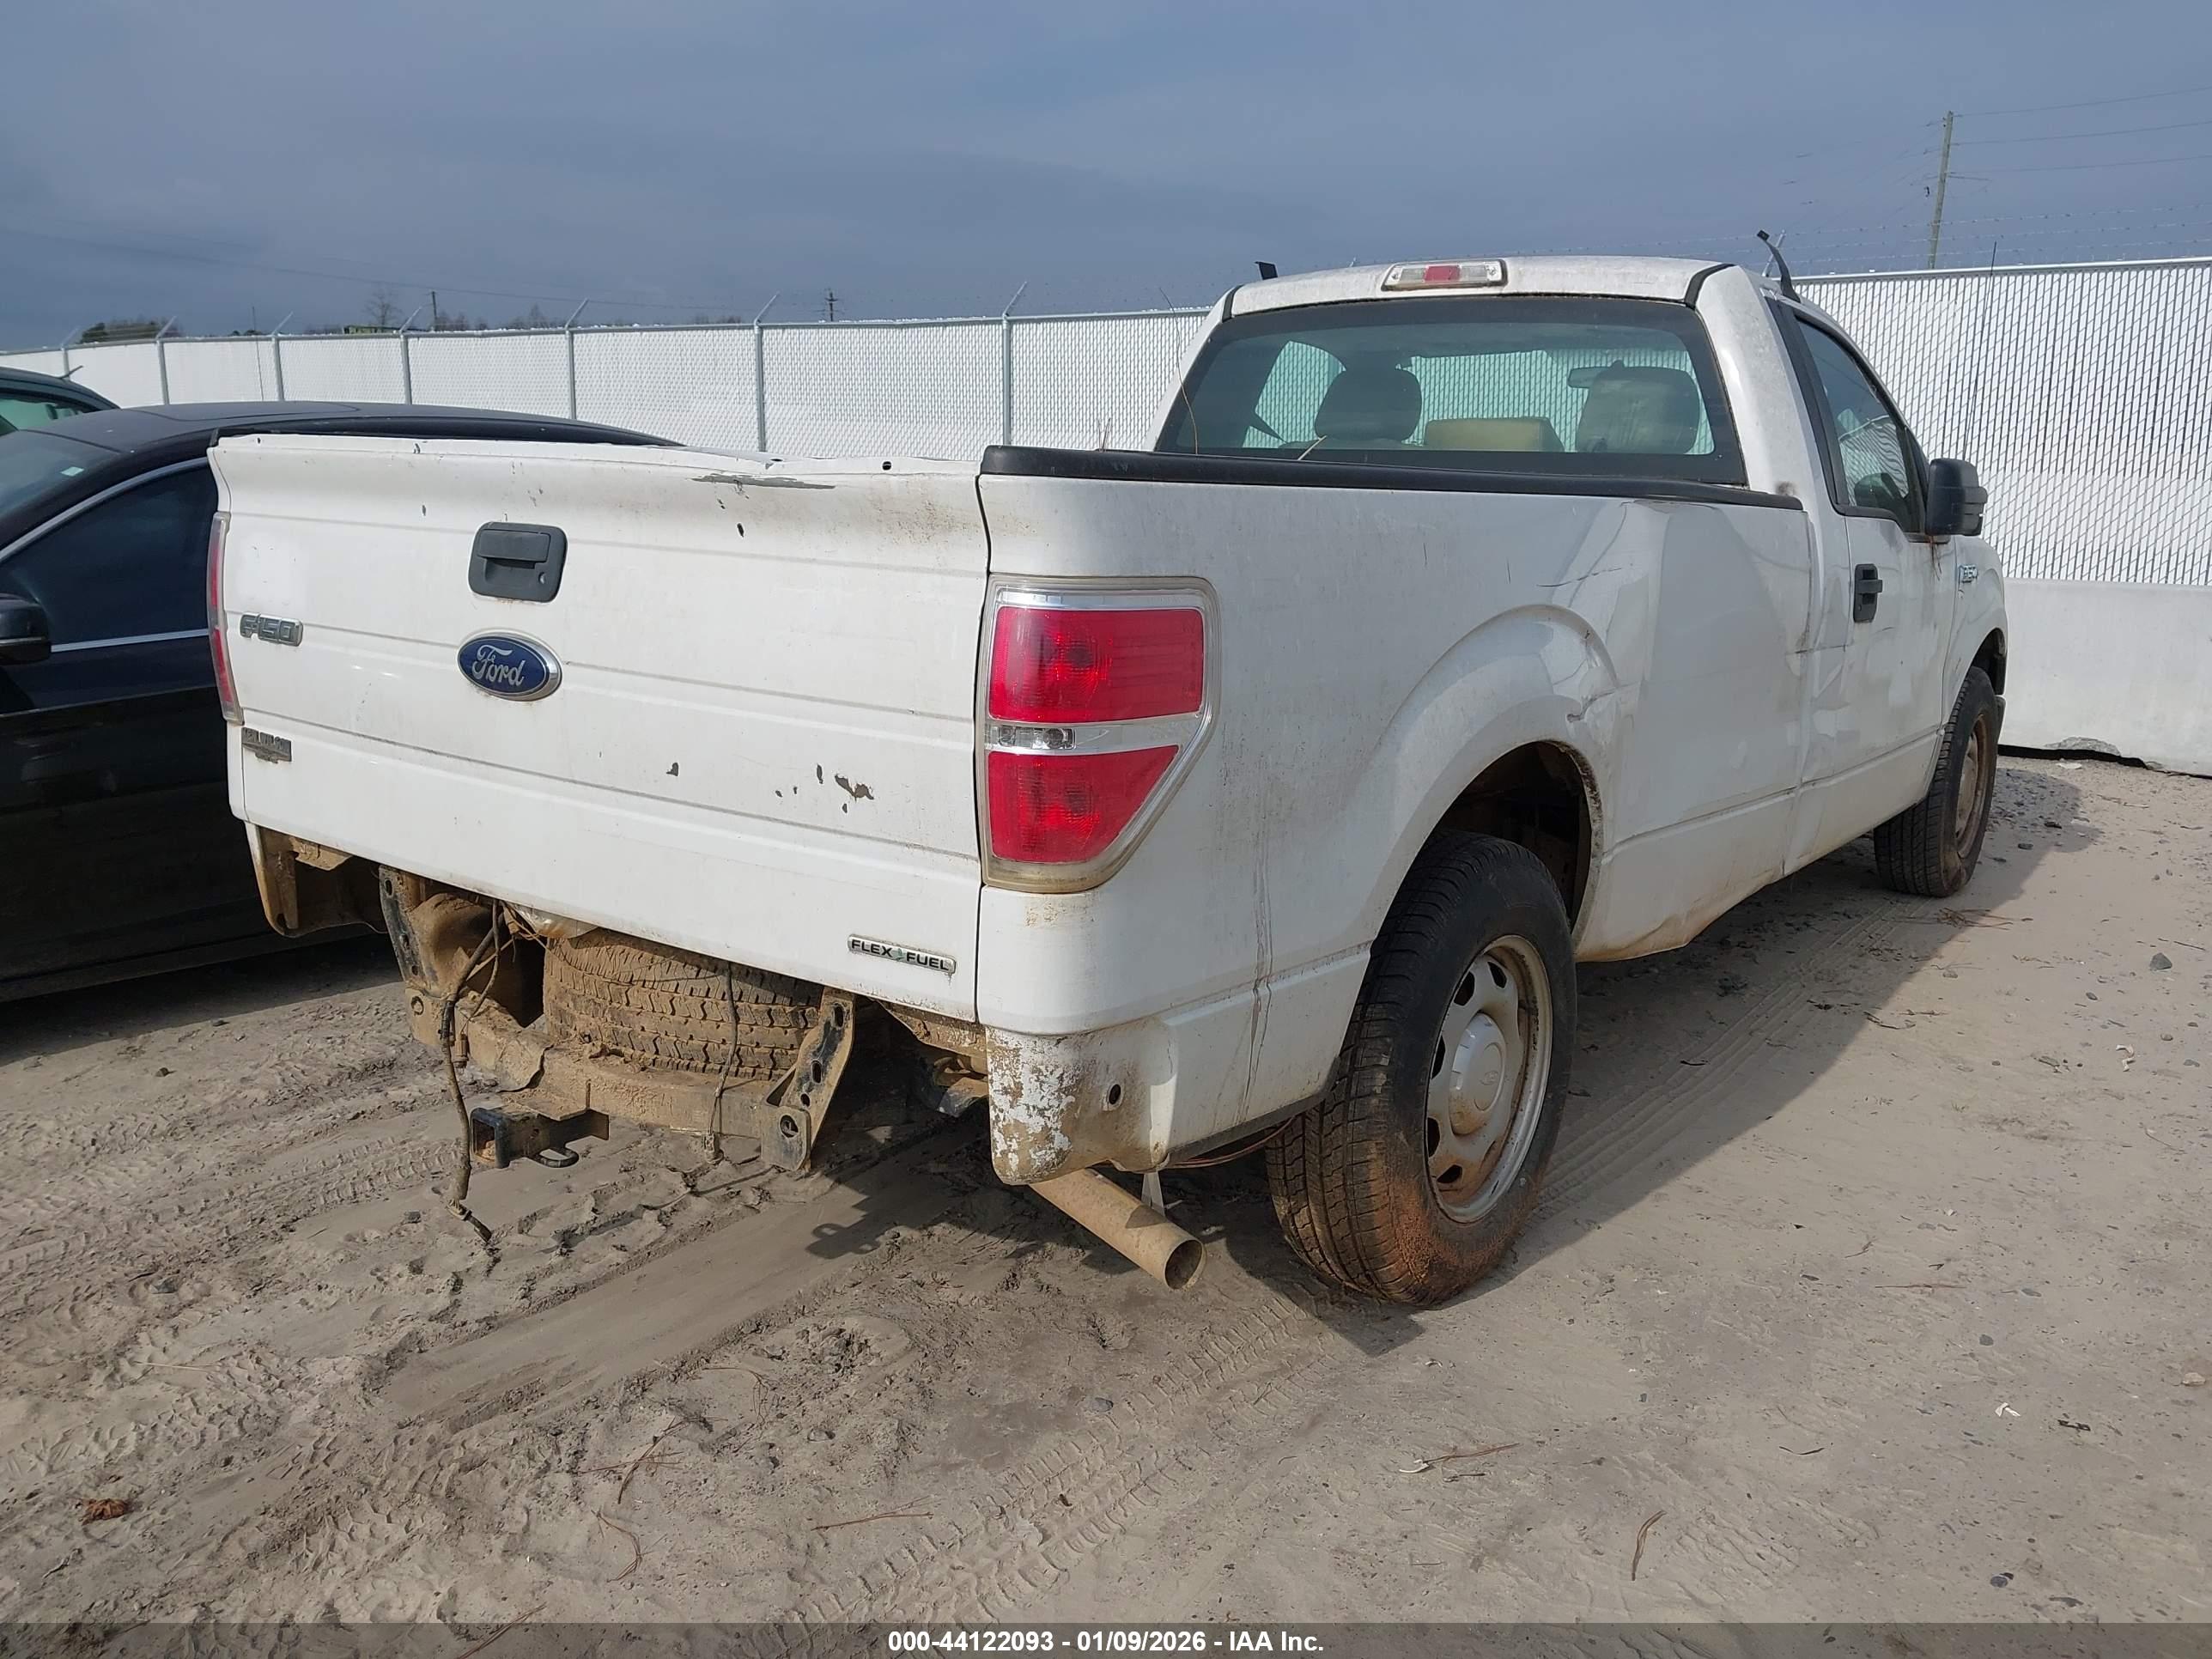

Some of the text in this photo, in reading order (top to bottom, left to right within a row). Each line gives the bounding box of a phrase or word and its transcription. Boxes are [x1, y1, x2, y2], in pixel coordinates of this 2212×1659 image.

[471, 645, 526, 686] Ford
[851, 939, 950, 971] FLEX FUEL
